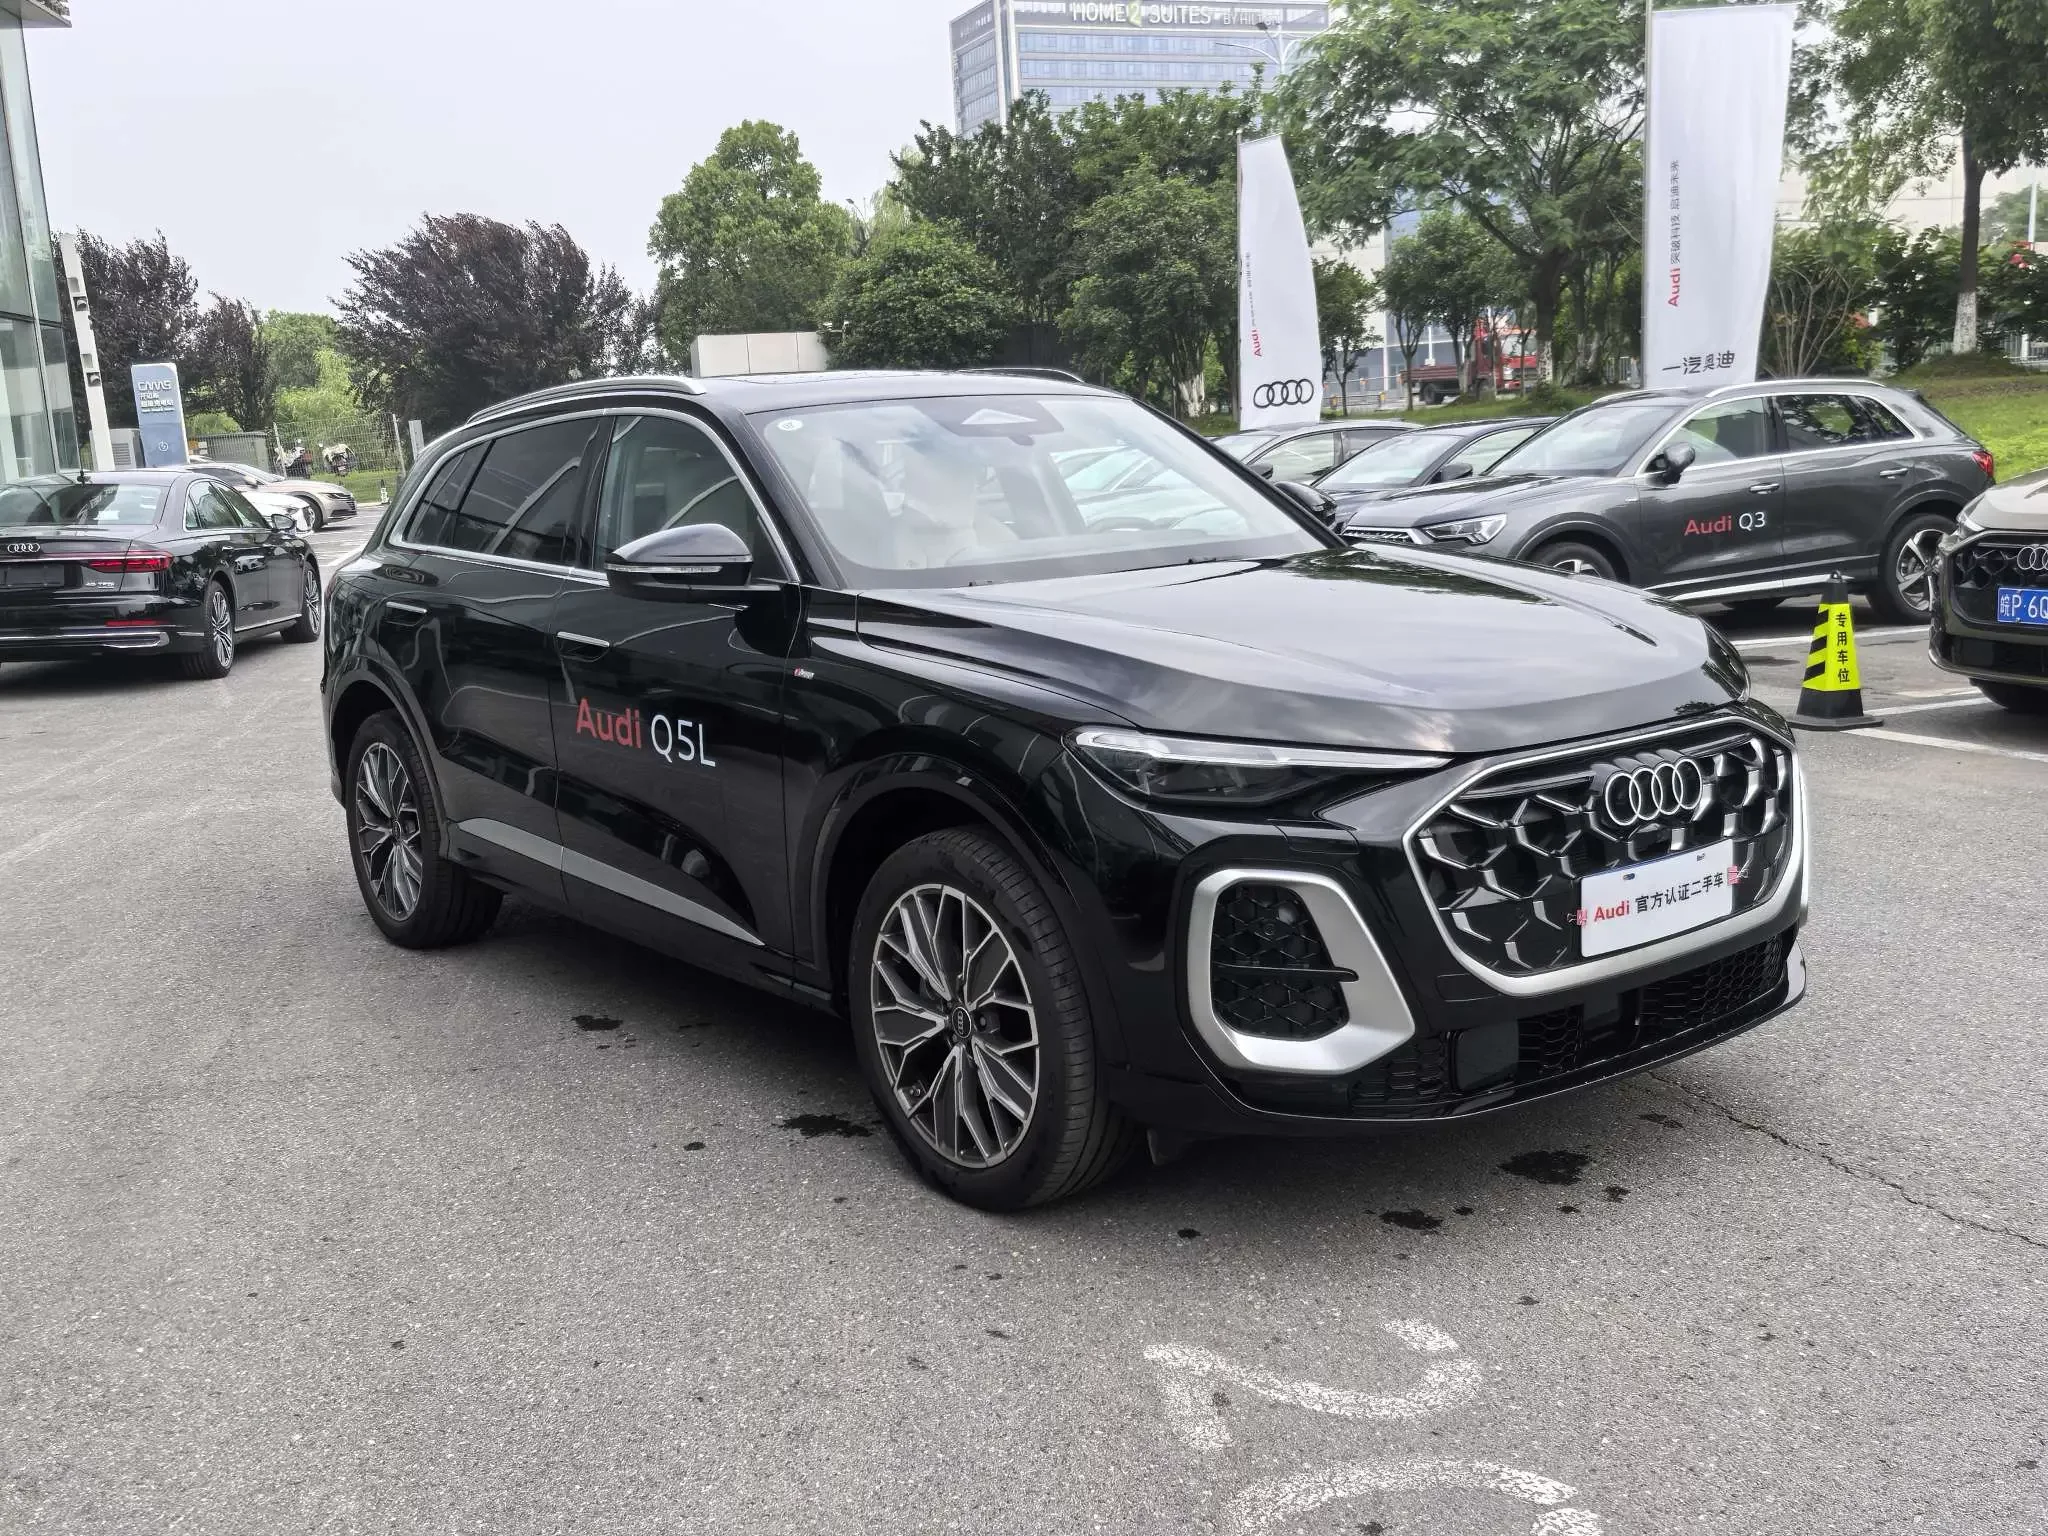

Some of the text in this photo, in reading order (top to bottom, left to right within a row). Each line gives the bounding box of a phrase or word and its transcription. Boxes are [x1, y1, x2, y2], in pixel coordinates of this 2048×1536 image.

[1149, 4, 1211, 24] SUITES
[1223, 12, 1237, 25] BY
[1667, 268, 1681, 307] Audi
[1251, 329, 1263, 357] Audi
[1662, 350, 1735, 375] 一汽奥迪
[1683, 511, 1766, 536] Audi Q3
[1834, 612, 1851, 684] 专用车位
[576, 697, 716, 767] Audi Q5L
[1594, 872, 1724, 922] Audi 官方认证二手车
